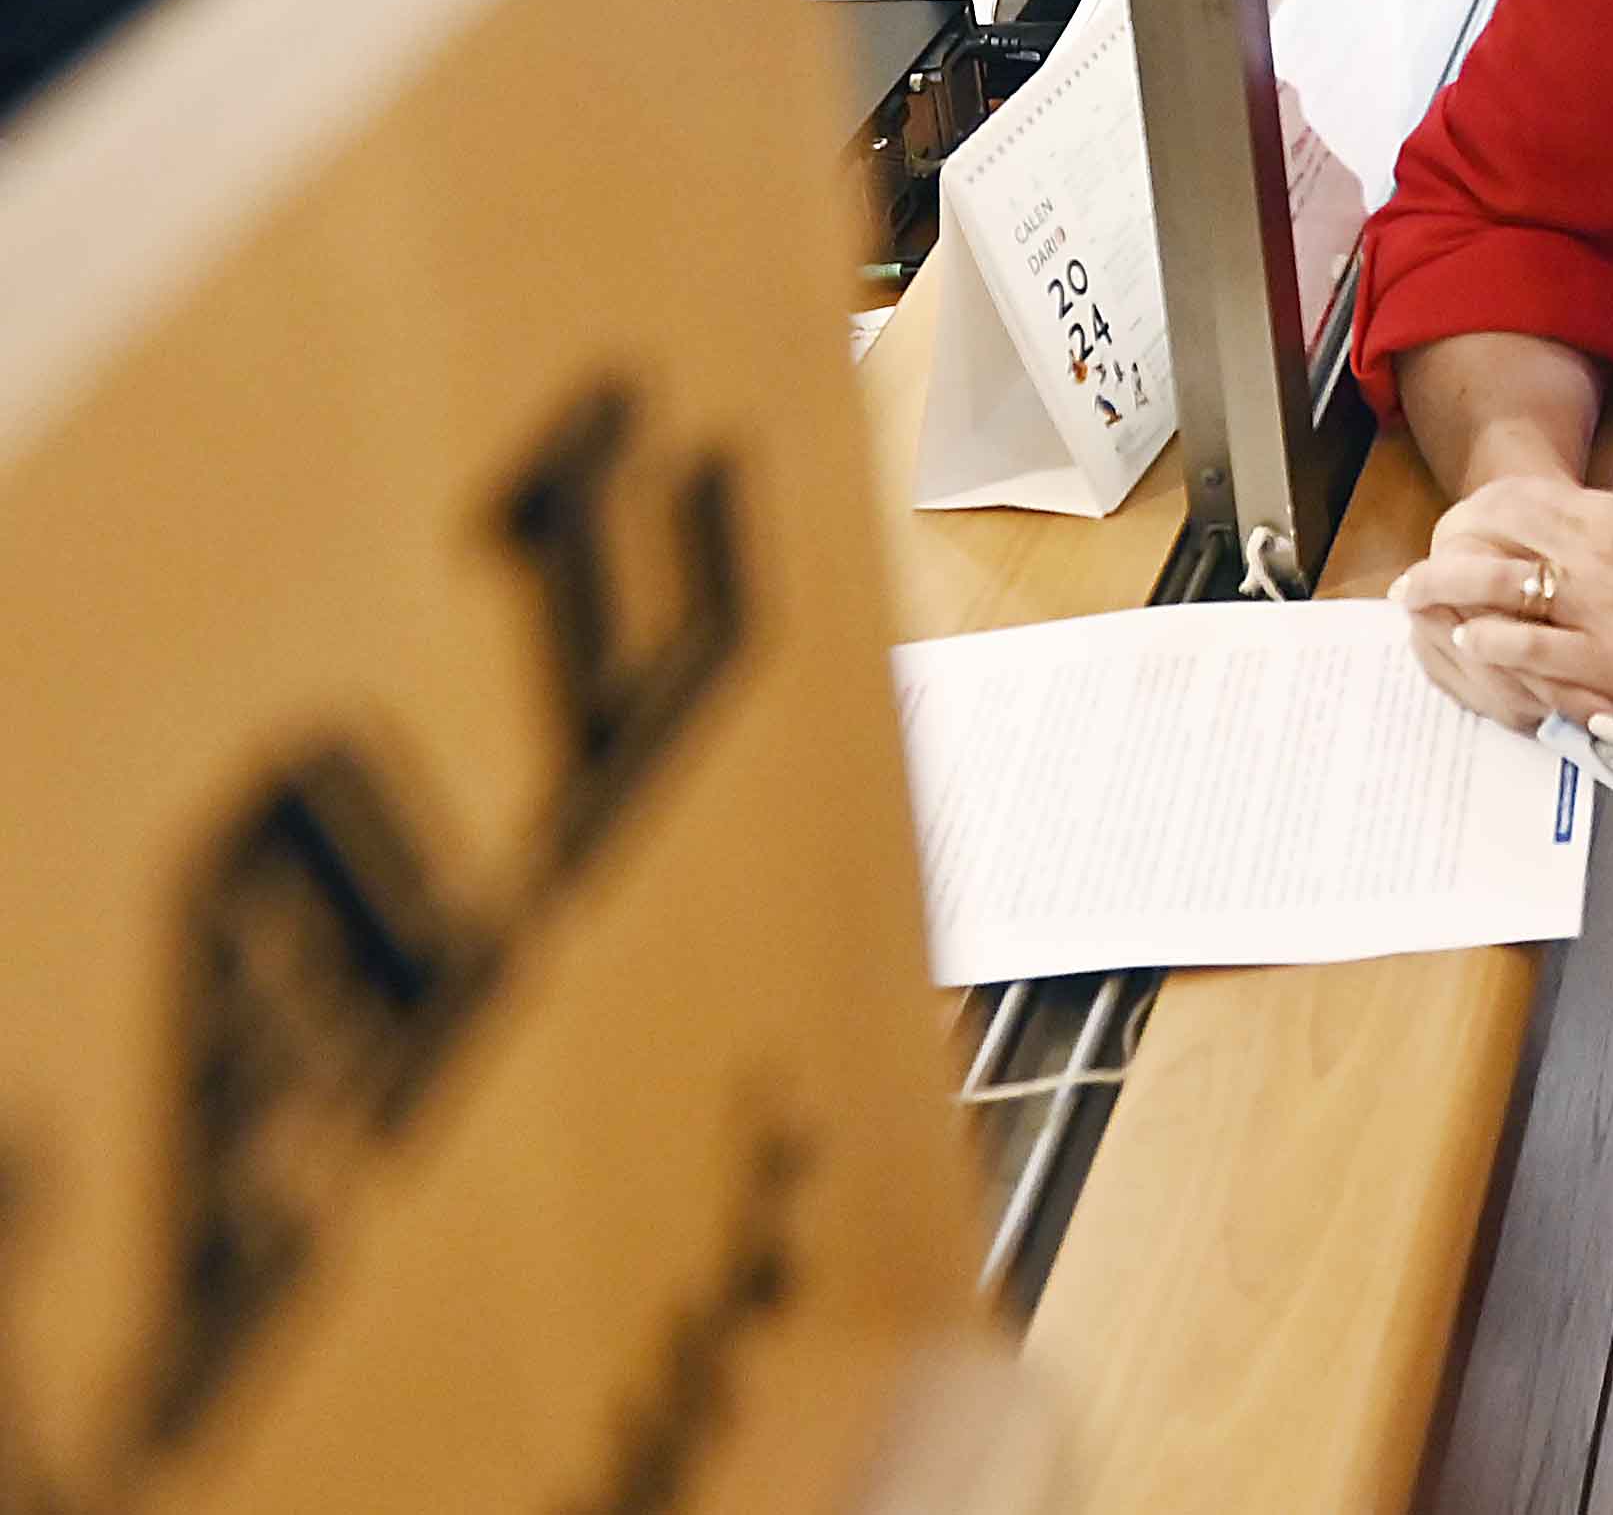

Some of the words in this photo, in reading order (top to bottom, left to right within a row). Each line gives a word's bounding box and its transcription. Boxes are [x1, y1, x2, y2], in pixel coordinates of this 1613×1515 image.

[1015, 197, 1054, 245] CALEN
[1028, 226, 1066, 276] DARIO
[1048, 258, 1089, 319] 20
[1068, 303, 1112, 361] 24
